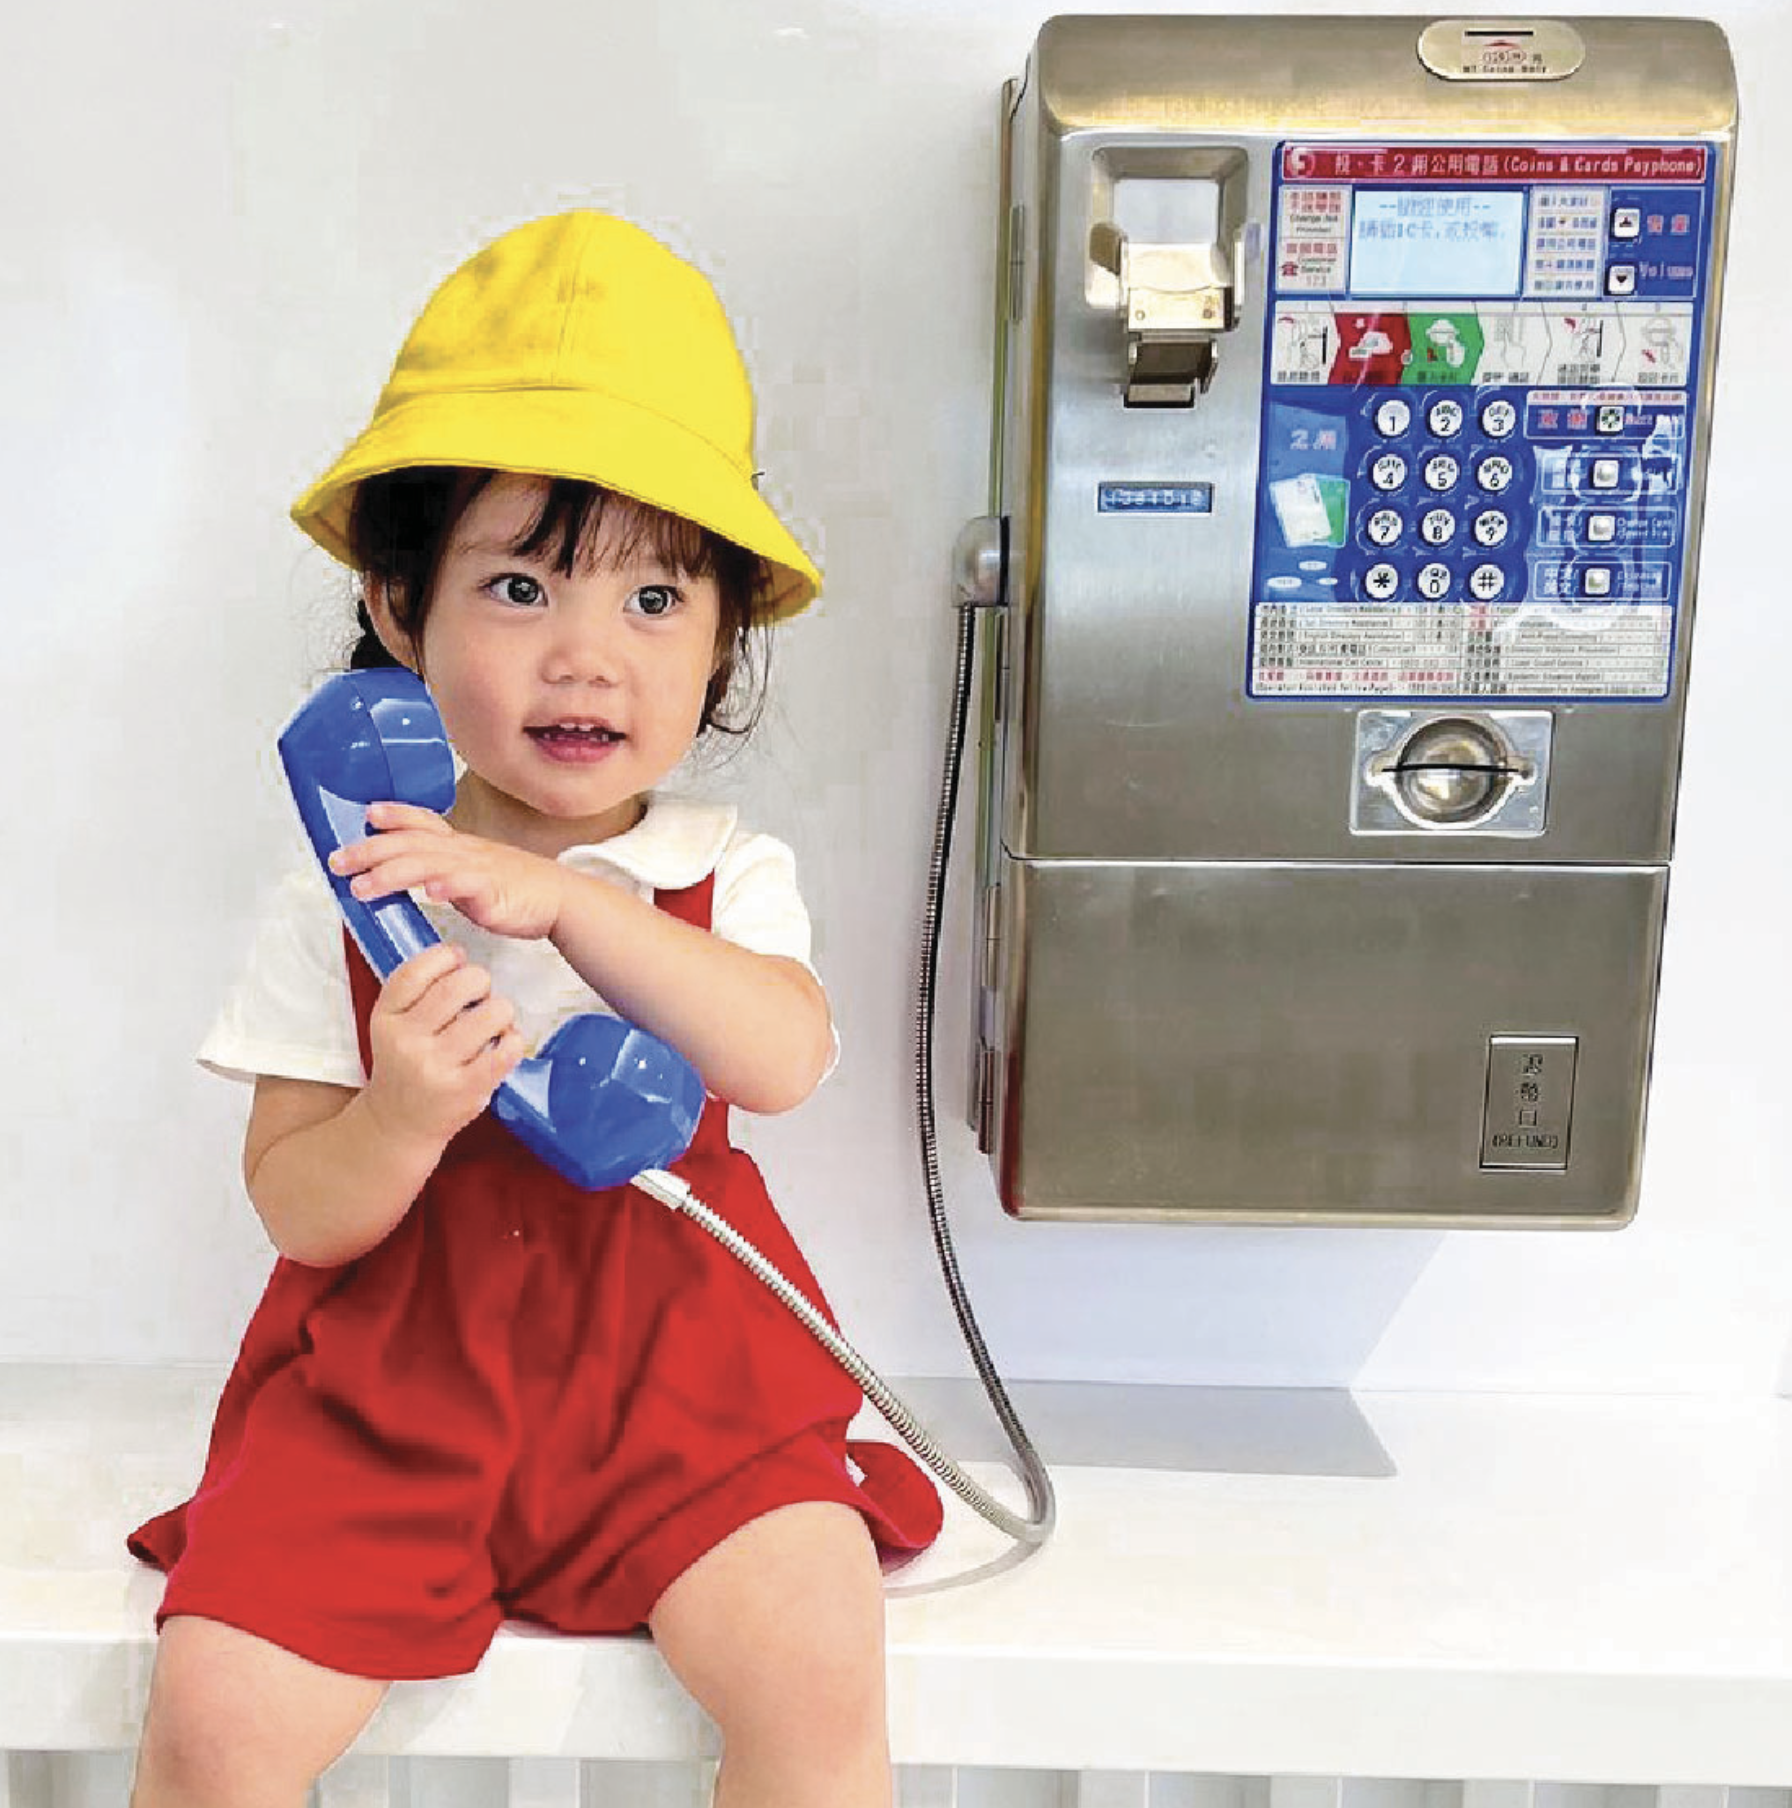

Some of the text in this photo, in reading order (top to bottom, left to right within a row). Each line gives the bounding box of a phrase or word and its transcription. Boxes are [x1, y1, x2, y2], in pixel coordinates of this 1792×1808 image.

[1503, 156, 1553, 173] (Coins
[1574, 156, 1618, 173] Cards
[1625, 155, 1700, 177] Payphone)
[1389, 415, 1396, 432] 1
[1440, 417, 1451, 431] 2
[1493, 418, 1504, 431] 3
[1383, 472, 1394, 486] 4
[1437, 472, 1447, 487] 5
[1490, 473, 1500, 487] 6
[1380, 525, 1390, 540] 7
[1433, 525, 1442, 540] 8
[1486, 526, 1497, 541] 9
[1430, 579, 1440, 594] 0
[1478, 571, 1498, 591] #
